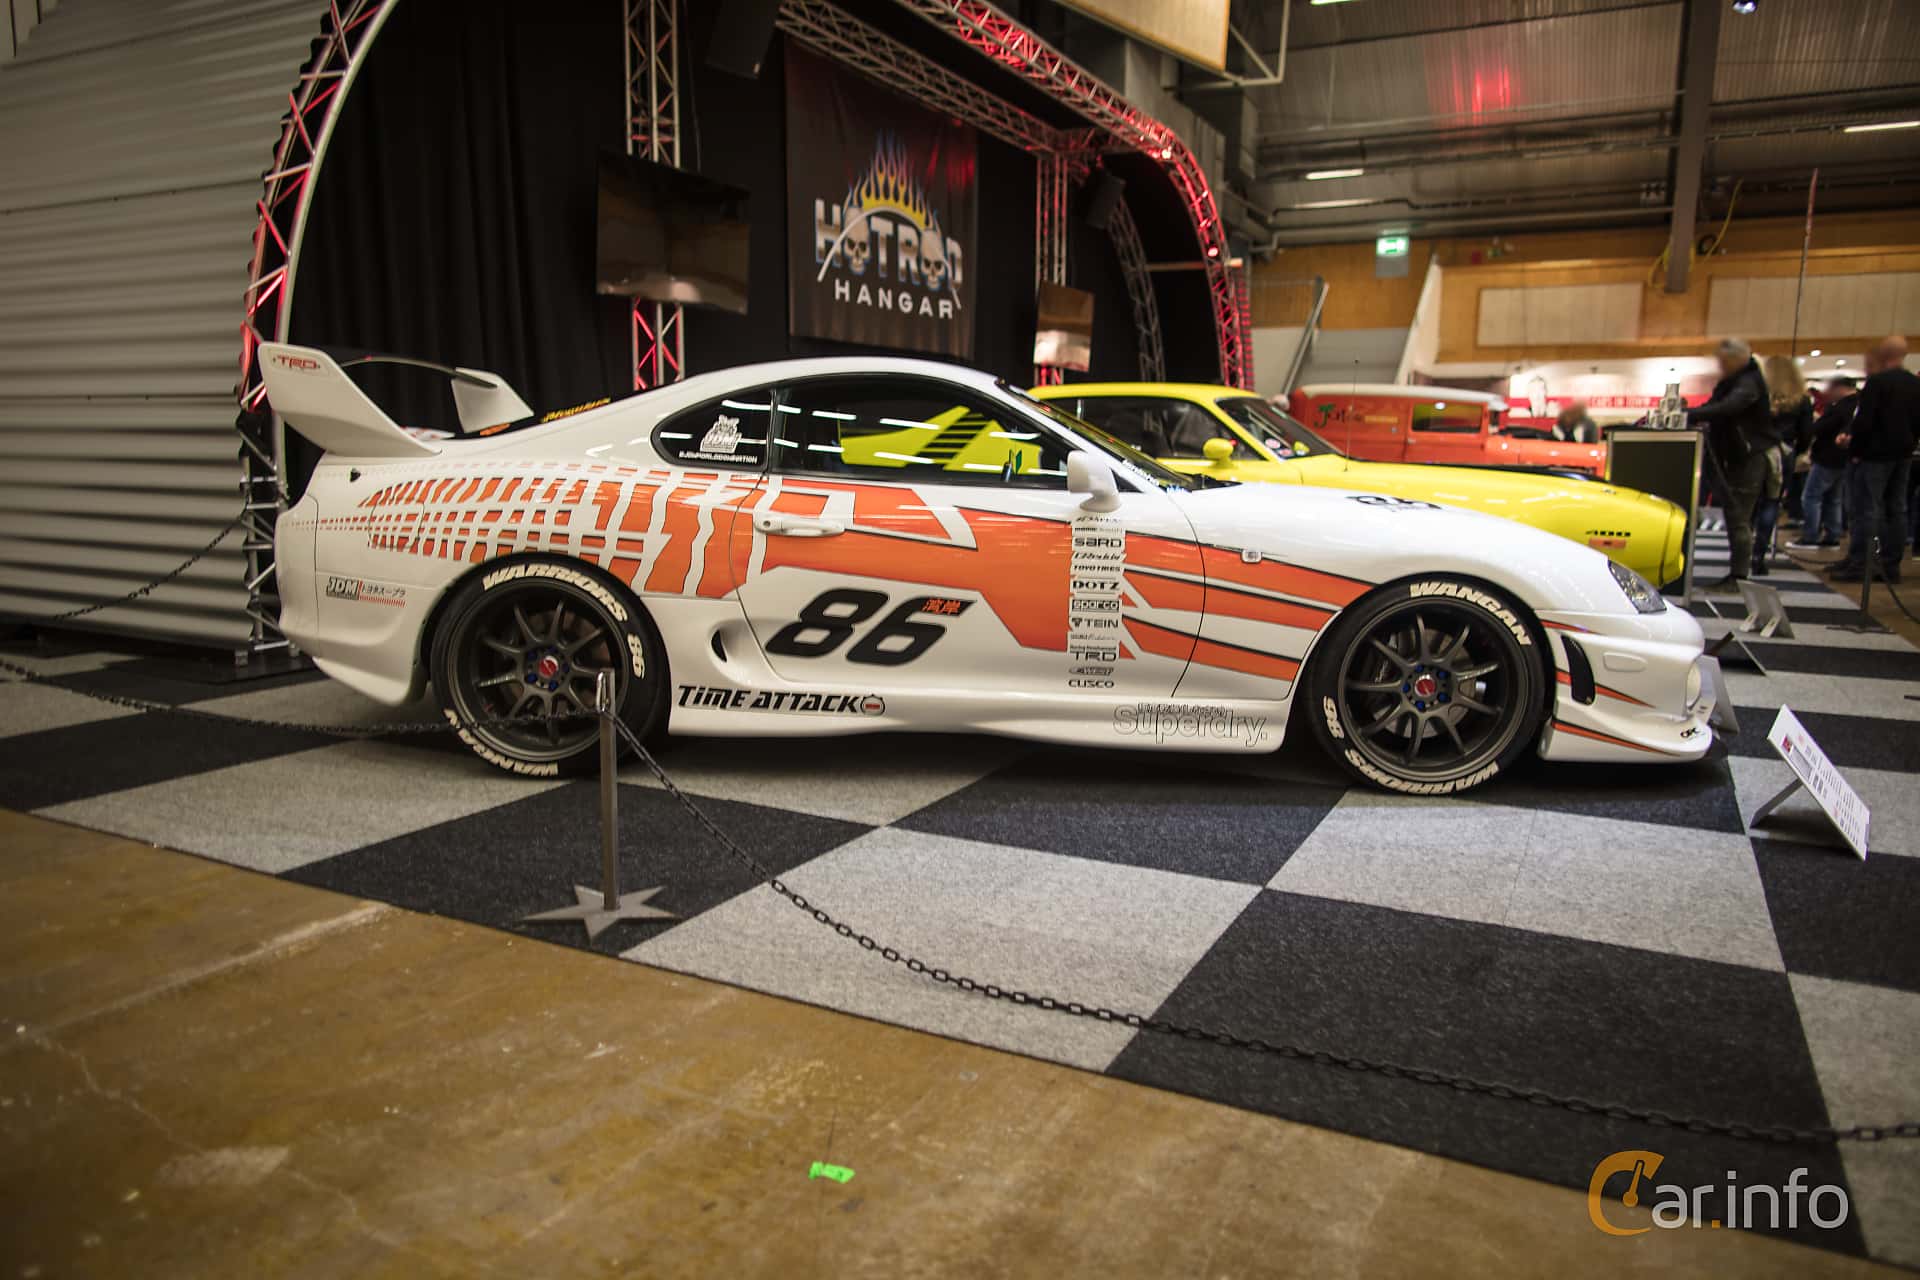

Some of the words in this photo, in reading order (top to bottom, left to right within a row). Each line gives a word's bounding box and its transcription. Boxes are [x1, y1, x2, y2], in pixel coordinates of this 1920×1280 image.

[834, 278, 954, 319] HANGAR
[277, 355, 318, 369] TRD
[327, 577, 359, 595] JDM
[1072, 580, 1121, 590] DOTZ
[482, 563, 628, 622] WARRIORS
[627, 633, 645, 680] 86
[1409, 581, 1532, 646] WANGAN
[765, 588, 977, 667] 86
[1084, 618, 1119, 628] TEIN
[1070, 650, 1117, 661] TRD
[1068, 679, 1114, 688] CUSCO
[750, 690, 859, 713] ATTACK
